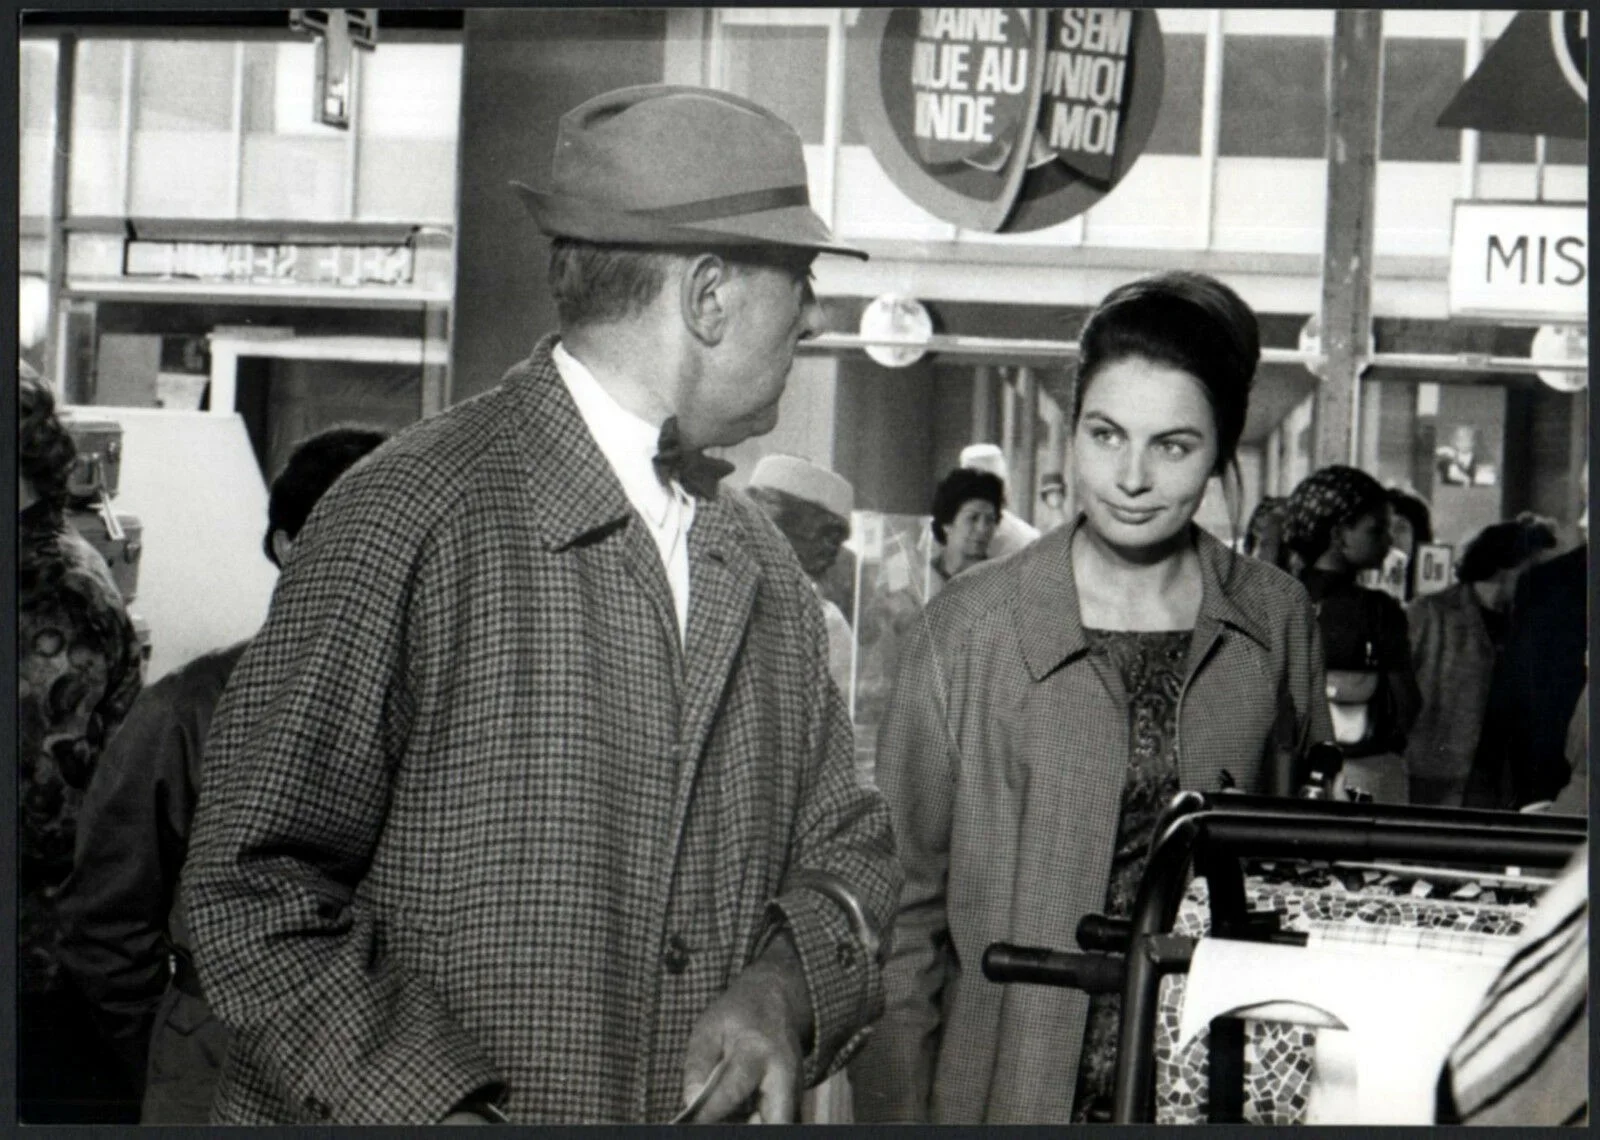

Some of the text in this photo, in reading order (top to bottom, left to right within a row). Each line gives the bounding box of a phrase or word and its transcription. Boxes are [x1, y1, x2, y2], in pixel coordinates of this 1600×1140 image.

[1061, 9, 1132, 56] SEM
[976, 46, 1029, 95] AU
[914, 92, 996, 143] NDE
[1486, 234, 1586, 286] MIS
